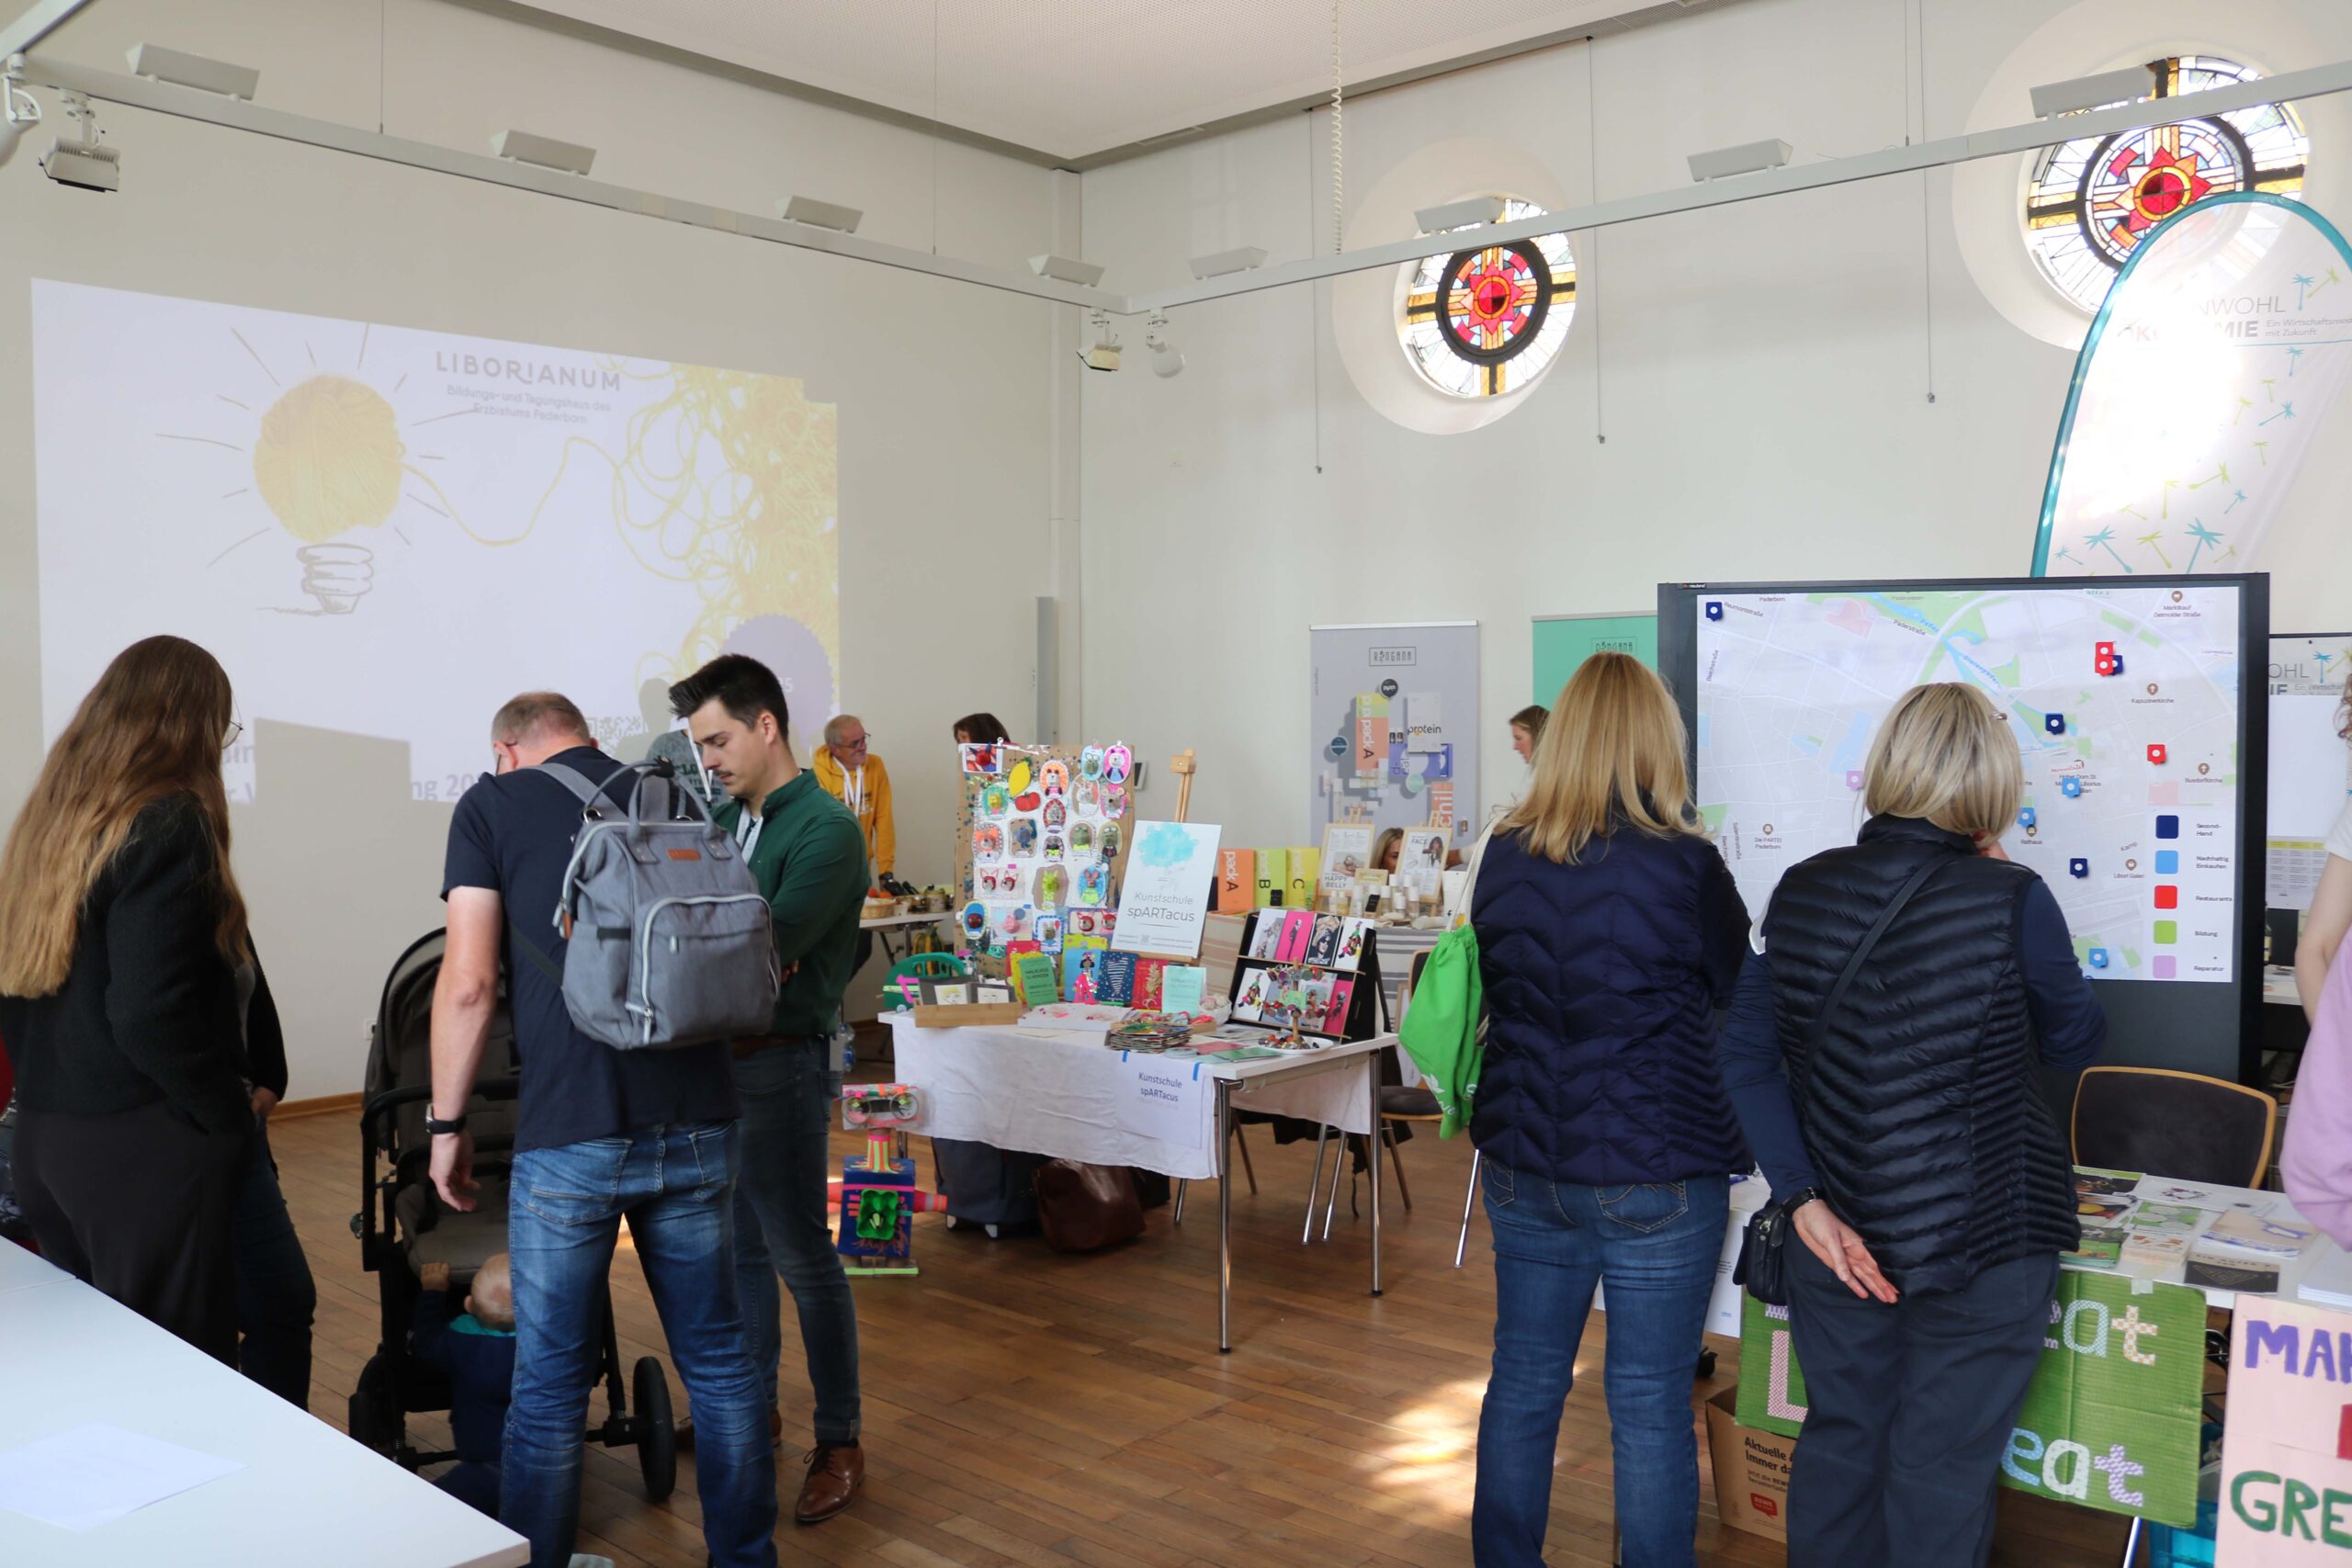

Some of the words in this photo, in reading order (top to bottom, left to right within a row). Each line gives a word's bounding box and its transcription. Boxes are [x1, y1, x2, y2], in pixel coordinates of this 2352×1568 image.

[436, 350, 621, 392] LIBORIANUM
[447, 384, 500, 402] Bildungs-
[502, 392, 523, 404] und
[525, 393, 590, 411] Tagungshaus
[592, 400, 611, 412] des
[473, 402, 533, 420] Erzbistums
[534, 407, 587, 424] Paderborn
[1408, 723, 1442, 735] protein
[1363, 749, 1374, 760] A
[1227, 880, 1239, 892] A
[1259, 879, 1272, 889] B
[1292, 878, 1305, 889] C
[1134, 890, 1194, 906] Kunstschule
[1126, 907, 1195, 922] spARTacus
[1138, 1072, 1182, 1089] Kunstschule
[1139, 1087, 1180, 1102] spARTacus
[1745, 1436, 1787, 1461] Aktuelle
[1746, 1450, 1779, 1471] Immer
